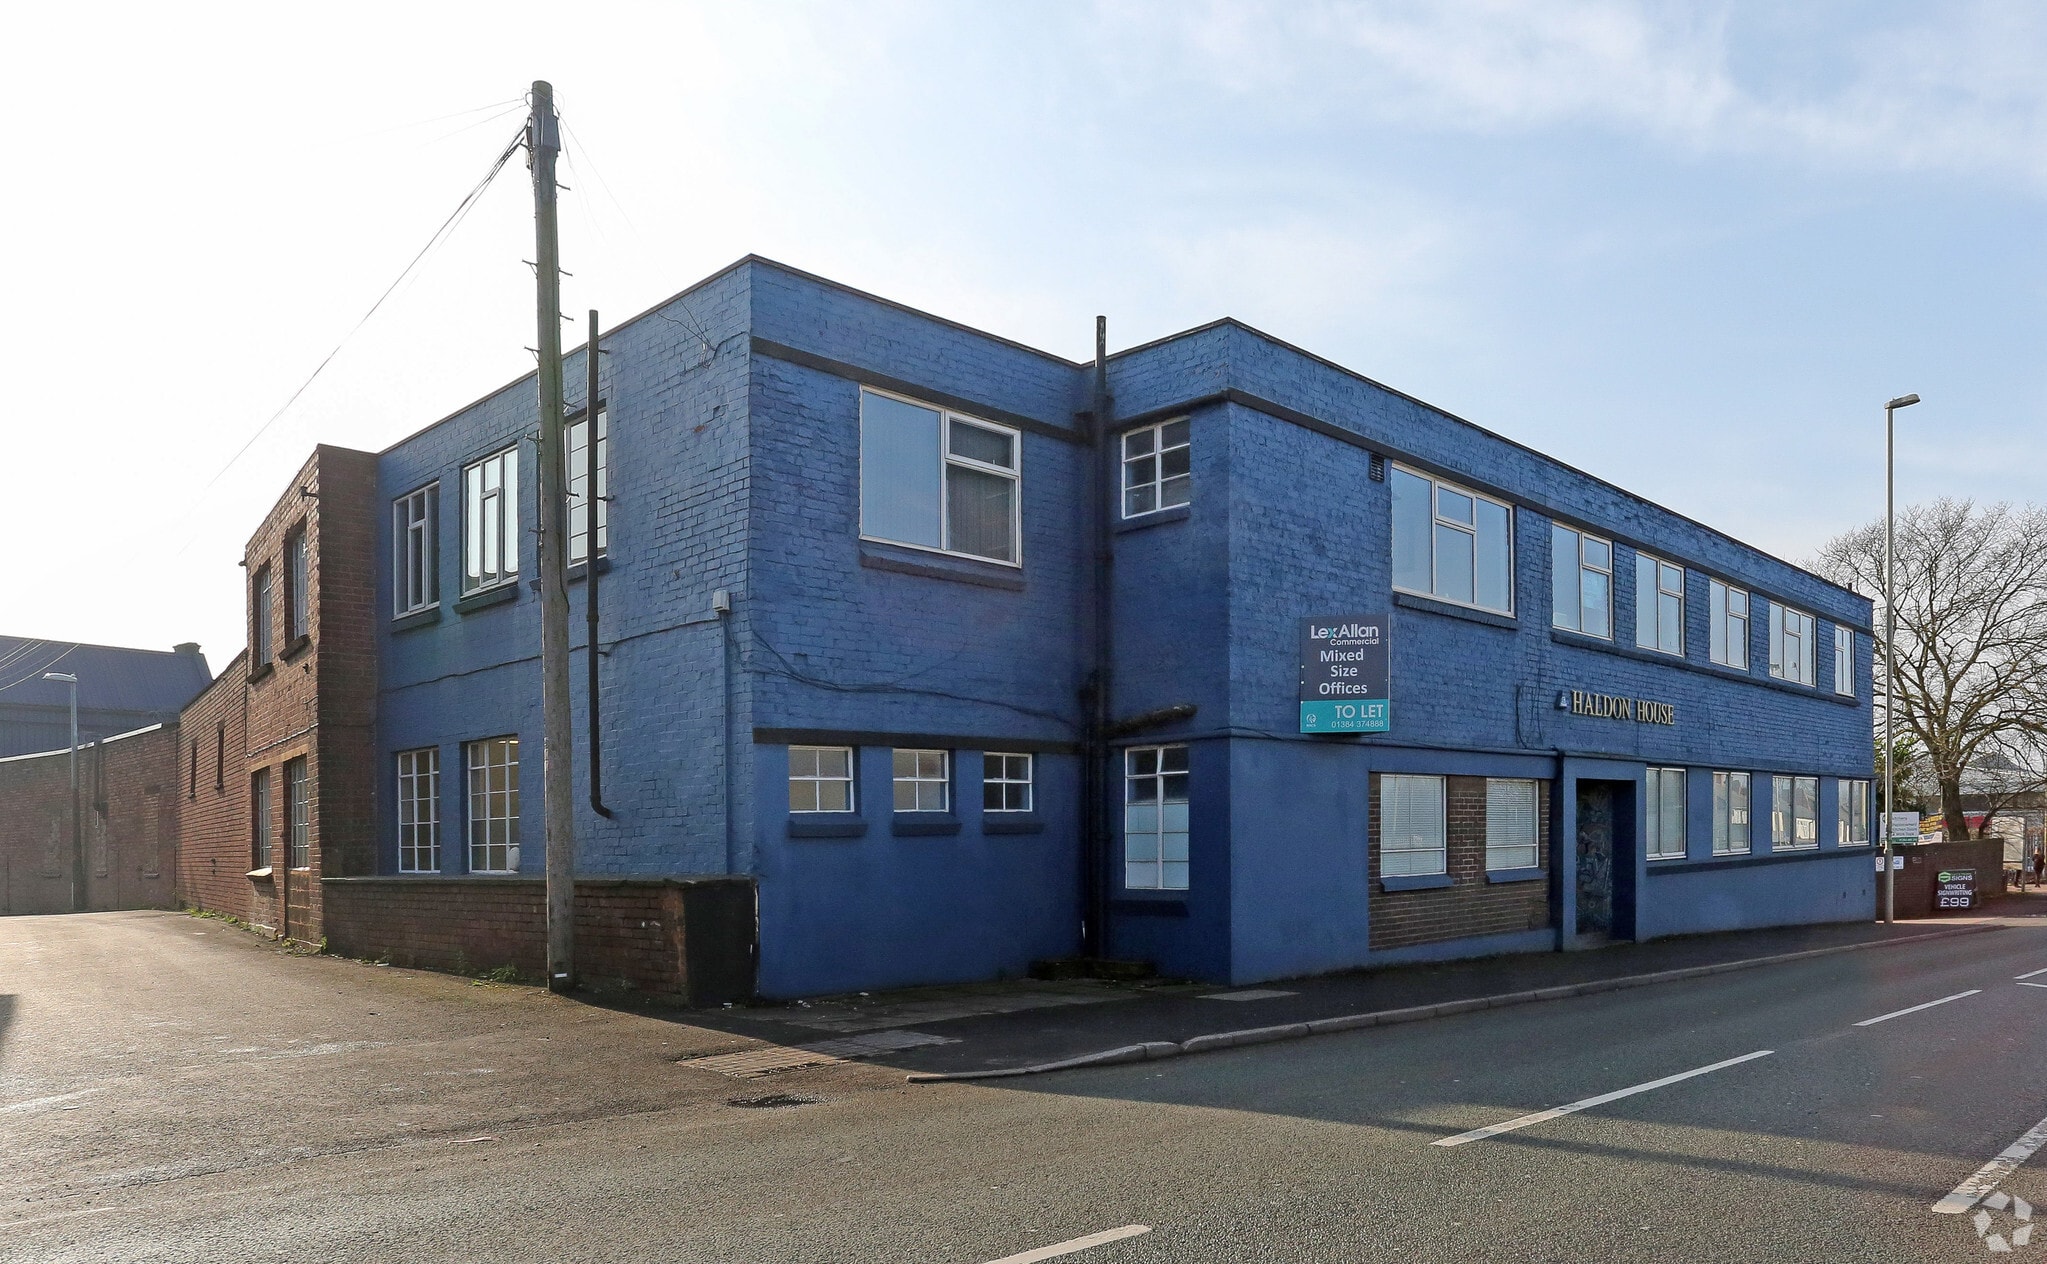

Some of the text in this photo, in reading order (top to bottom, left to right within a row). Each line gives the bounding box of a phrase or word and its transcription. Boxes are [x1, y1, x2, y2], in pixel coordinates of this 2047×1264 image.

[1329, 638, 1379, 646] Commercial
[1320, 648, 1364, 662] Mixed
[1330, 664, 1358, 677] Size
[1319, 682, 1368, 695] Offices
[1335, 704, 1384, 719] TO LET
[1572, 690, 1675, 725] HALDON HOUSE
[1331, 720, 1384, 728] 01384 374888
[1940, 897, 1969, 907] £99
